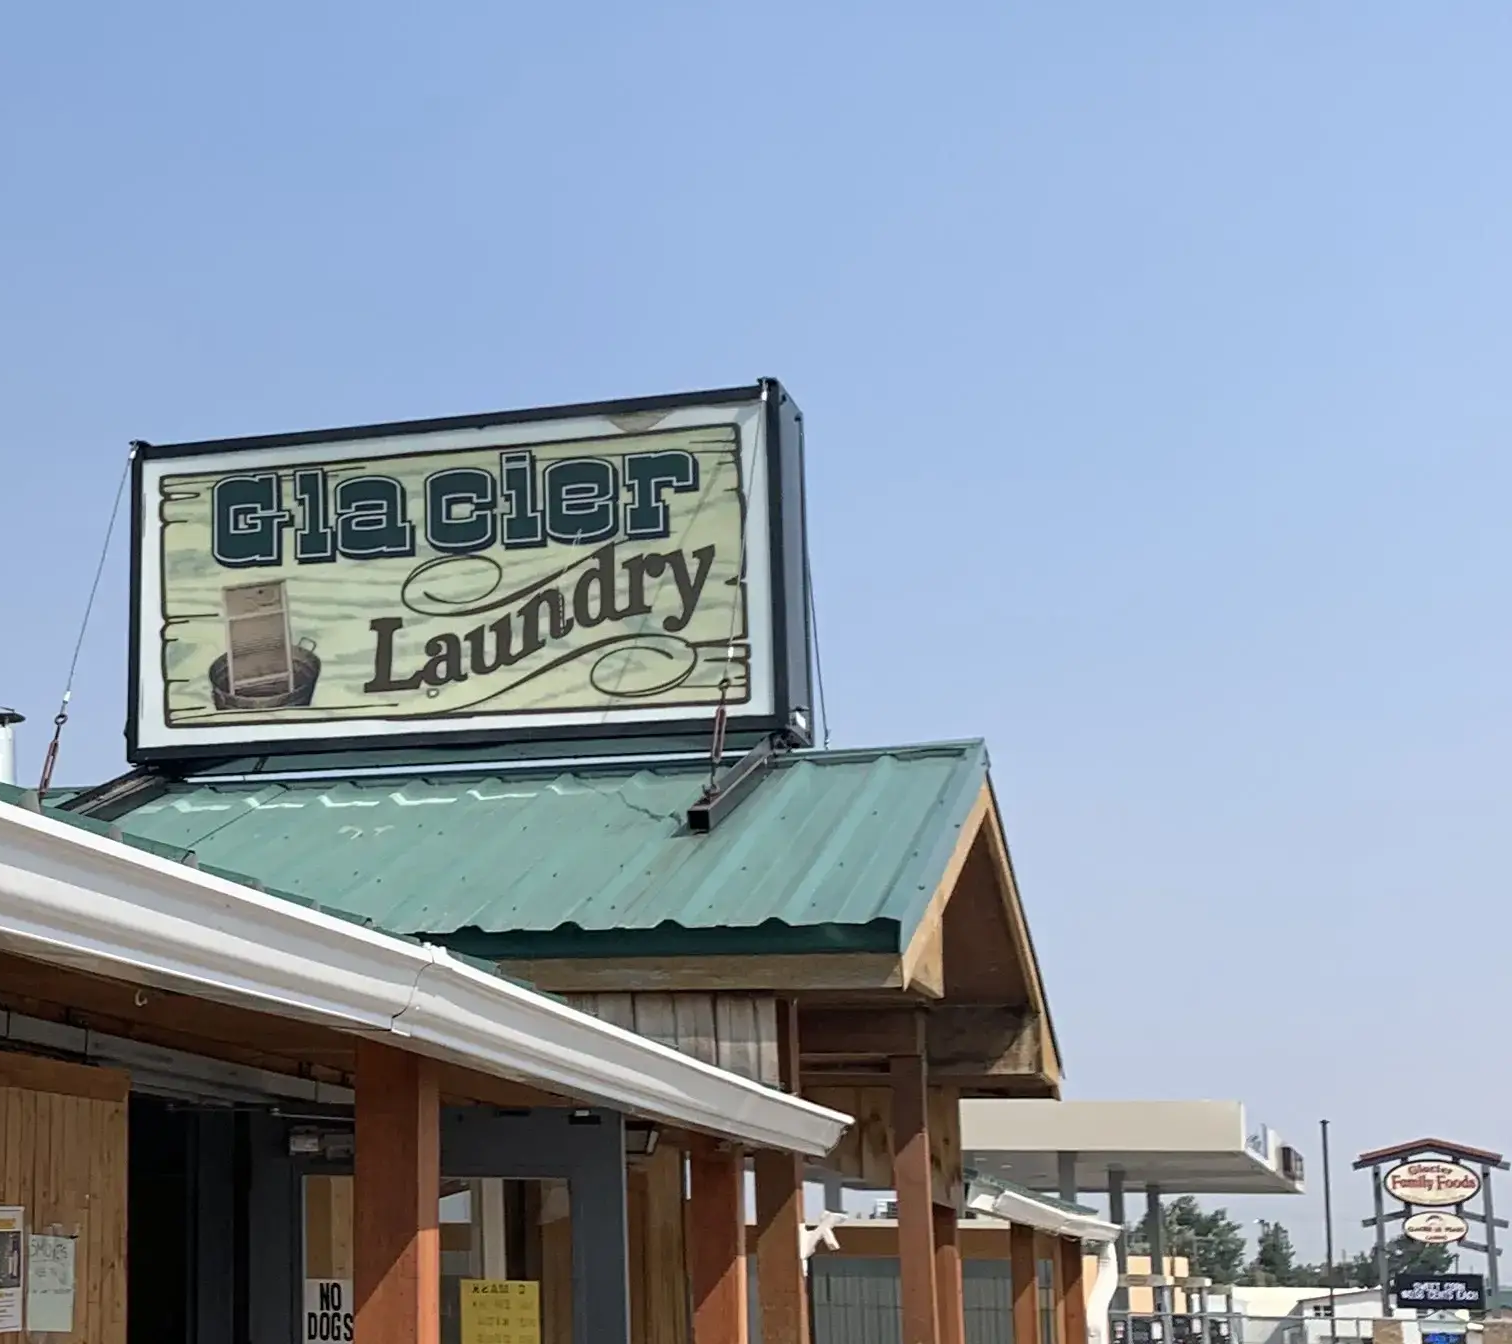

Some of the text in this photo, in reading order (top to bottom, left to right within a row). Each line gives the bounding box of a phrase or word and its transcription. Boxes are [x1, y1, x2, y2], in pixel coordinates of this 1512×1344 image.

[212, 449, 699, 568] Glacier
[364, 542, 716, 694] Laundry
[1391, 1174, 1476, 1191] Family Foods
[1408, 1164, 1453, 1175] Glacier
[319, 1282, 342, 1311] NO
[307, 1311, 354, 1342] DOGS
